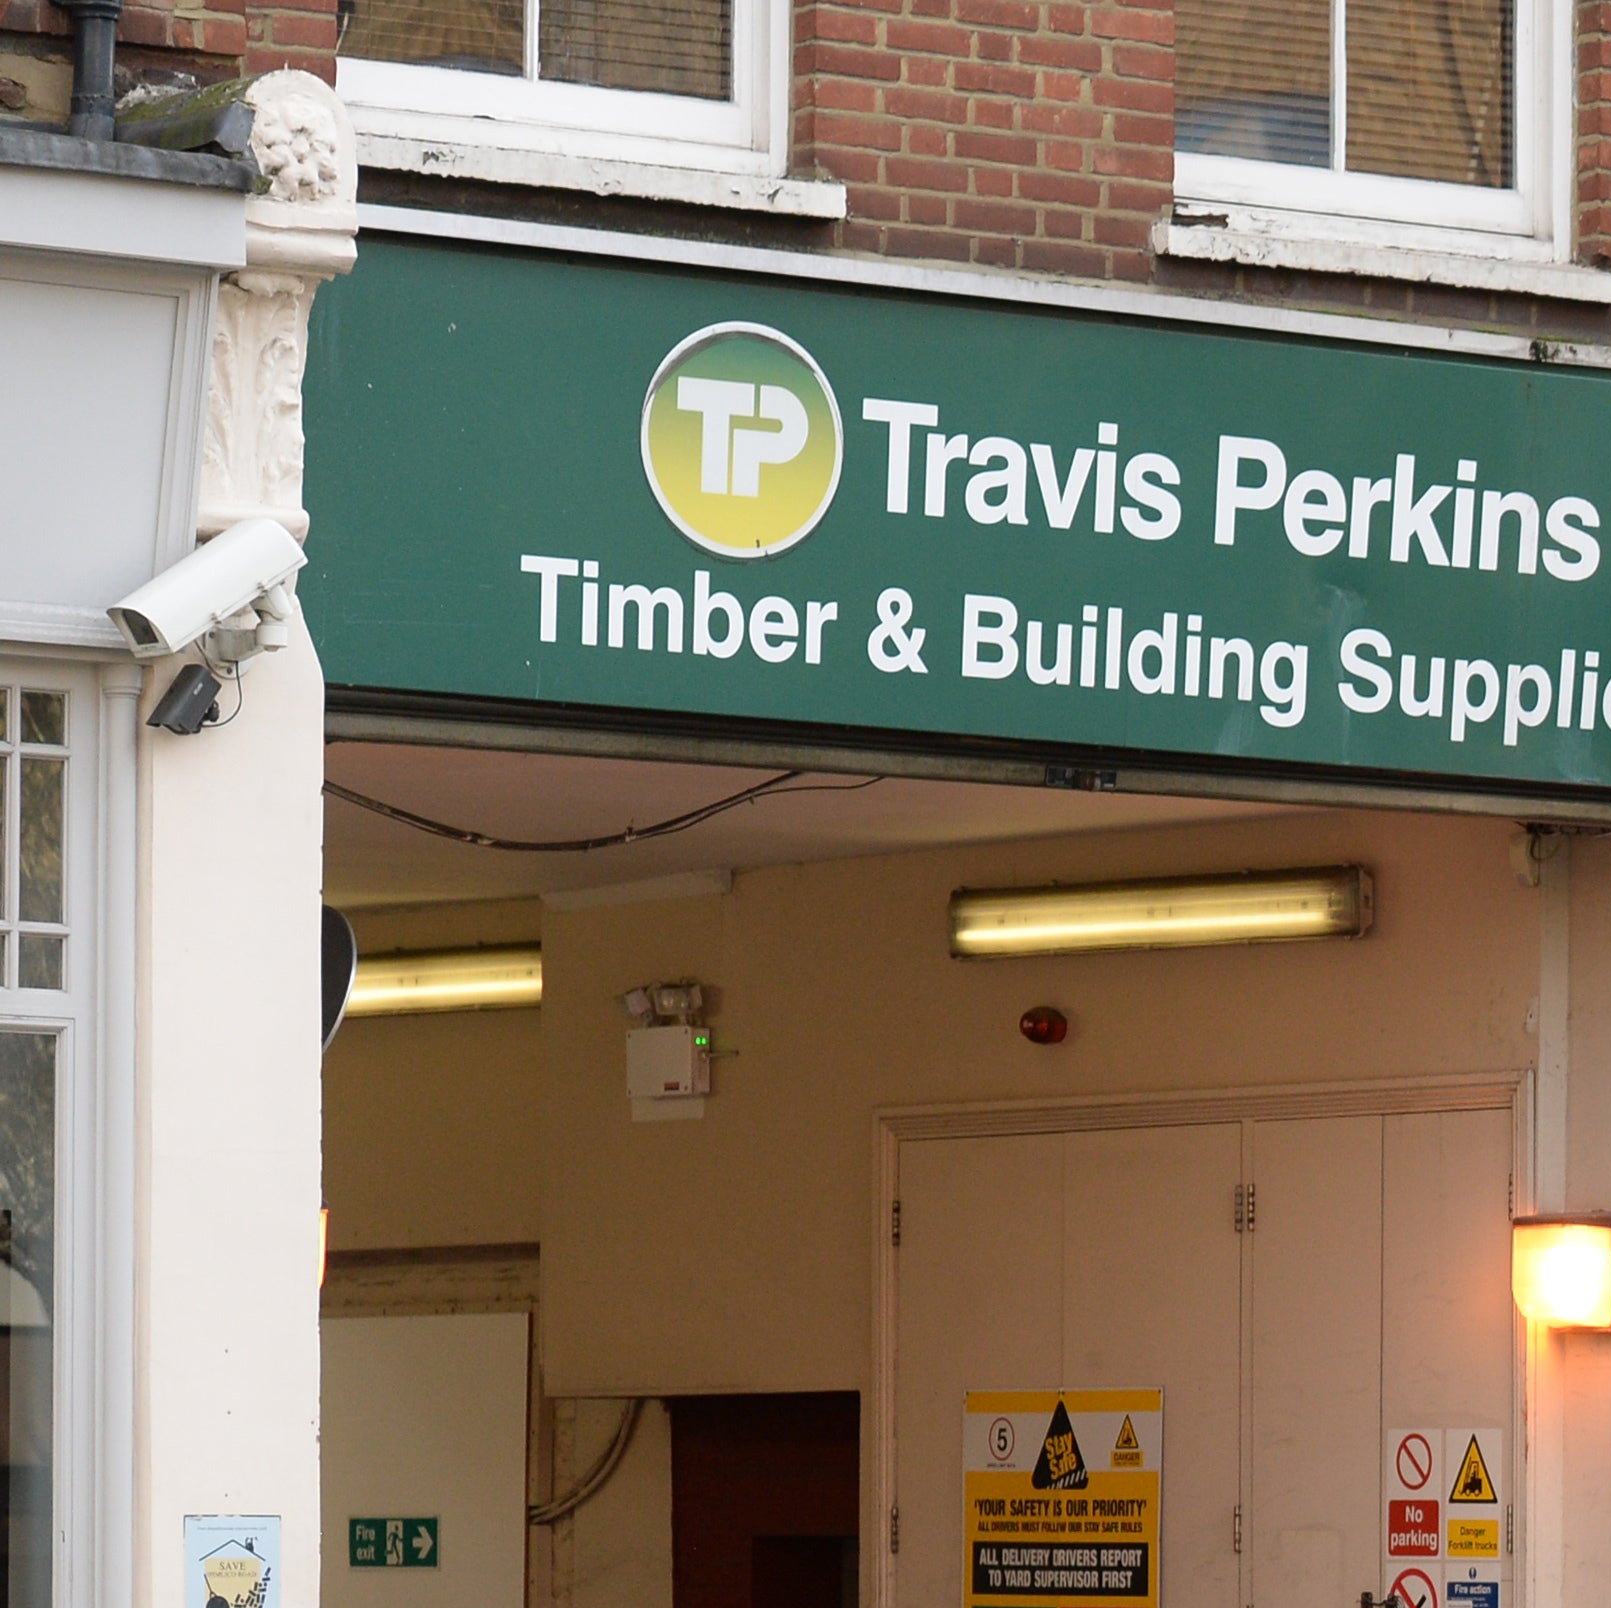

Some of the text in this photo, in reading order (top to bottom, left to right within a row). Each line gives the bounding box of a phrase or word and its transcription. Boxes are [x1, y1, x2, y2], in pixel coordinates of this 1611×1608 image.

[677, 376, 808, 496] TP
[863, 399, 1600, 581] Travis Perkins
[520, 554, 838, 661] Timber
[867, 587, 928, 673] &
[963, 593, 1309, 727] Building
[997, 1427, 1008, 1452] 5
[1045, 1431, 1073, 1461] Stay
[1049, 1451, 1077, 1480] Safe
[1010, 1499, 1049, 1517] SAFETY
[1053, 1500, 1062, 1517] IS
[1066, 1500, 1088, 1517] OUR
[1404, 1505, 1424, 1524] No
[356, 1525, 375, 1541] Fire
[1390, 1530, 1438, 1552] parking
[1459, 1526, 1487, 1537] Danger
[356, 1545, 376, 1561] exit
[1448, 1539, 1497, 1551] Forklift trucks
[219, 1561, 246, 1571] SAVE
[979, 1549, 1142, 1567] ALL DELIVERY DRIVERS REPORT
[988, 1570, 1133, 1589] TO YARD SUPERVISOR FIRST
[1454, 1584, 1492, 1595] Fire action
